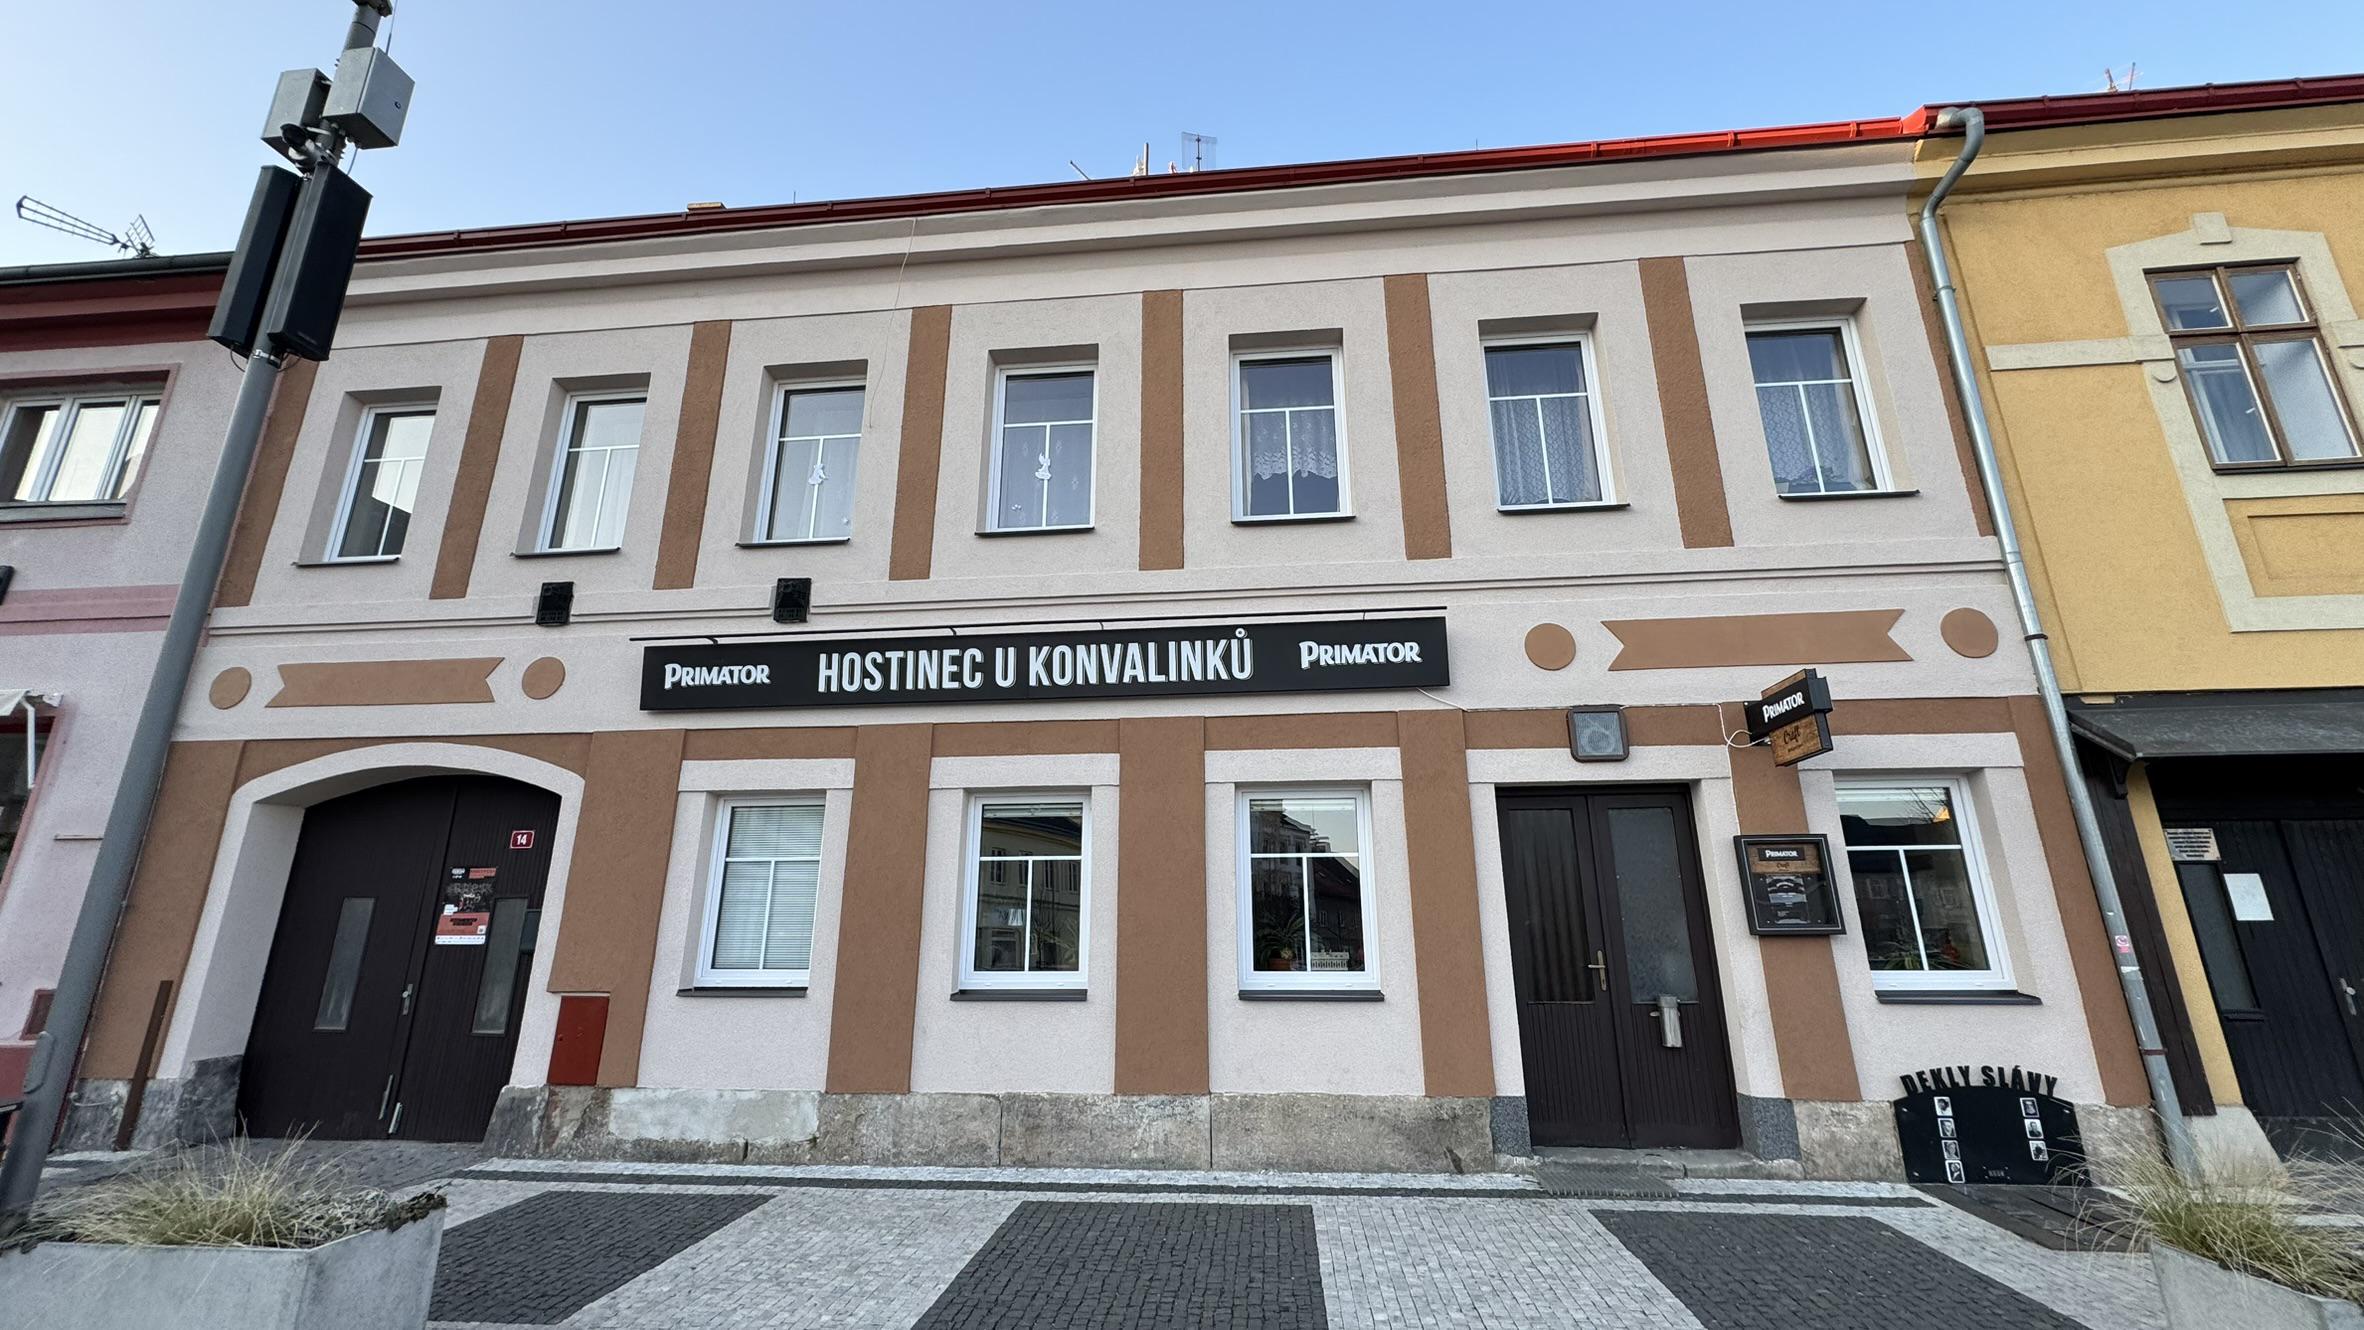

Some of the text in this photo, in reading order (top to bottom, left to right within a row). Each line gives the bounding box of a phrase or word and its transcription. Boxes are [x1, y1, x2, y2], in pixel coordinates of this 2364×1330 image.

[818, 627, 1254, 693] HOSTINEC U KONVALINKŮ
[1299, 641, 1424, 670] PRIMATOR
[664, 663, 771, 690] PRIMATOR
[1762, 691, 1805, 723] PRIMATOR
[516, 834, 527, 845] 14
[1900, 1065, 2058, 1097] DEKLY SLÁVY
